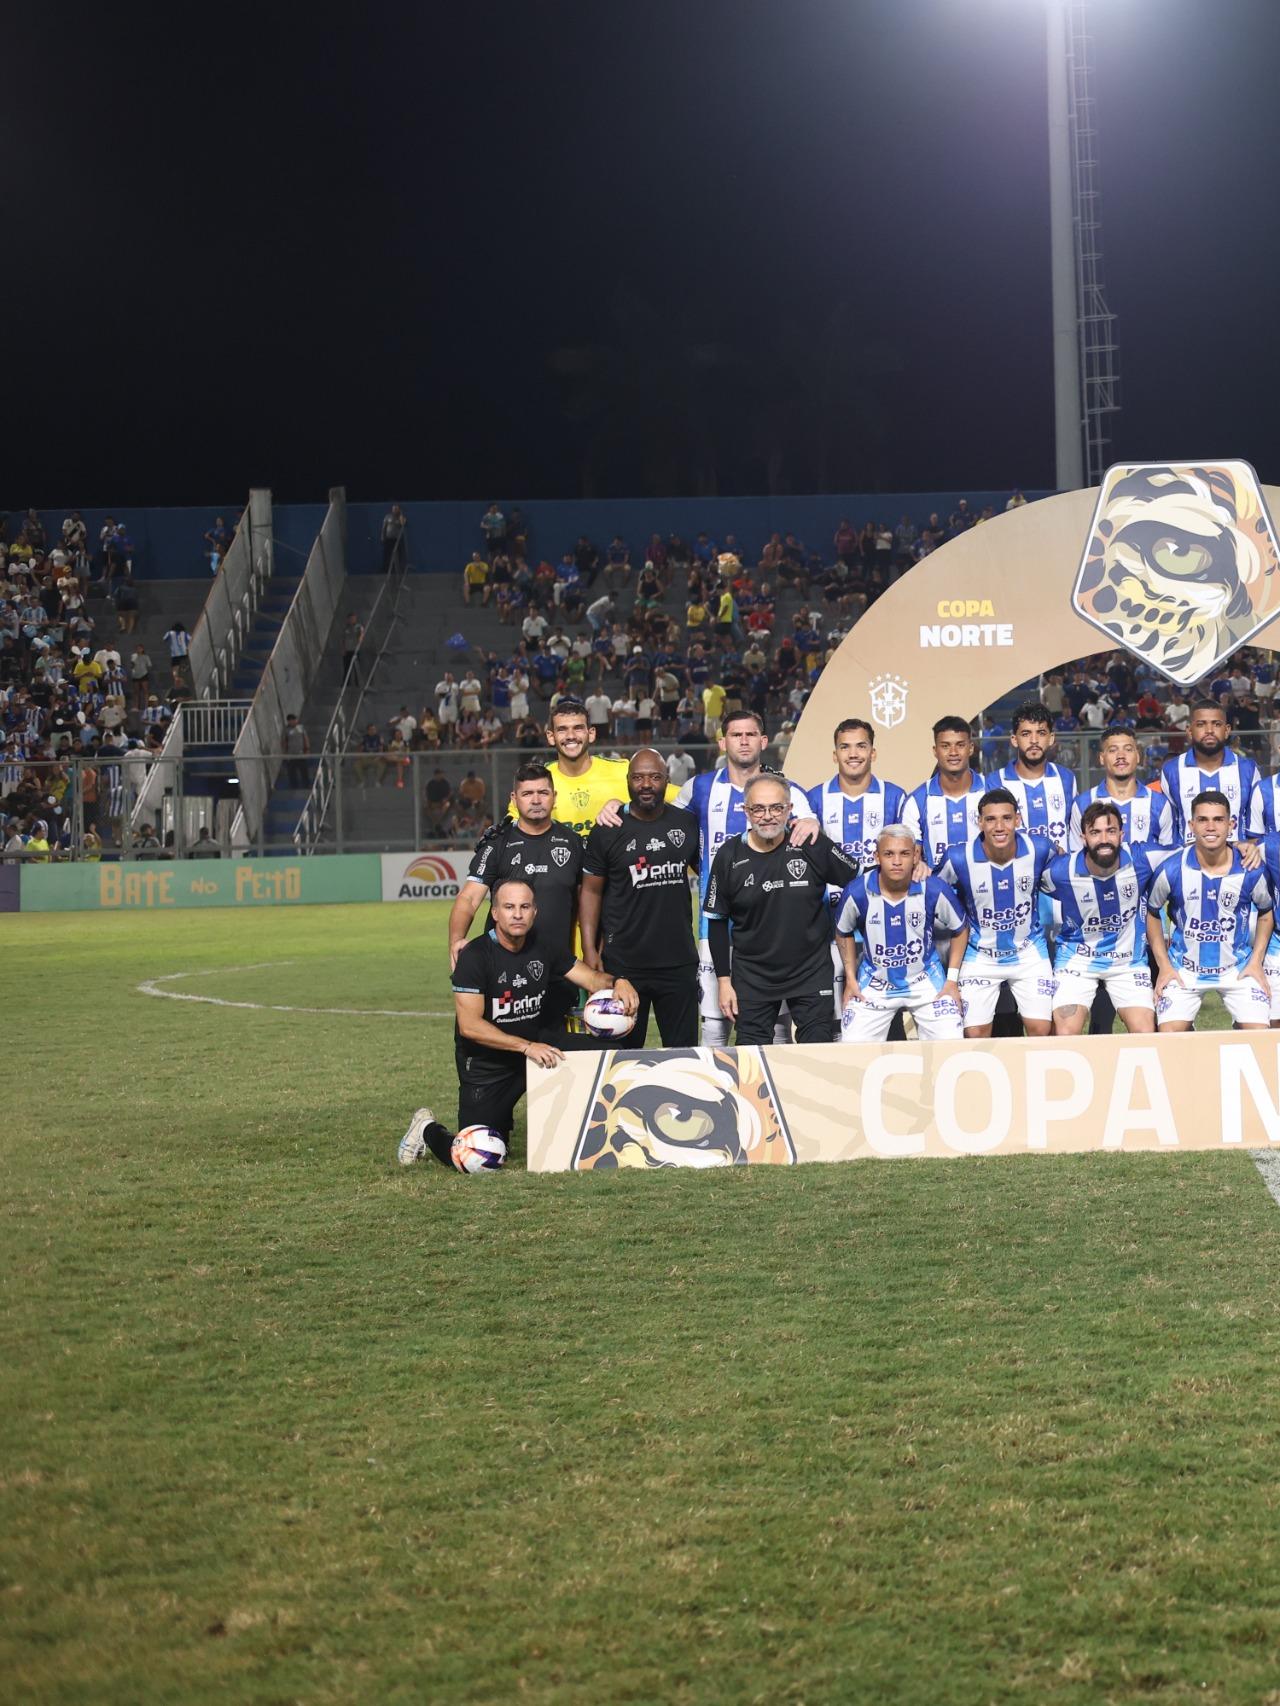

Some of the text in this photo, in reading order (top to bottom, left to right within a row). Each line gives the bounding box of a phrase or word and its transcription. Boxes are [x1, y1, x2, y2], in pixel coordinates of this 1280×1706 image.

[937, 600, 995, 618] COPA
[919, 623, 1014, 649] NORTE
[100, 864, 175, 907] BATE
[398, 884, 460, 900] Aurora
[982, 908, 1013, 920] Bet
[1088, 914, 1121, 926] Bet
[992, 918, 1026, 931] Sorte
[1189, 917, 1218, 931] Bet
[875, 943, 905, 957] Bet
[882, 956, 919, 968] Sorte
[860, 1046, 1179, 1156] COPA
